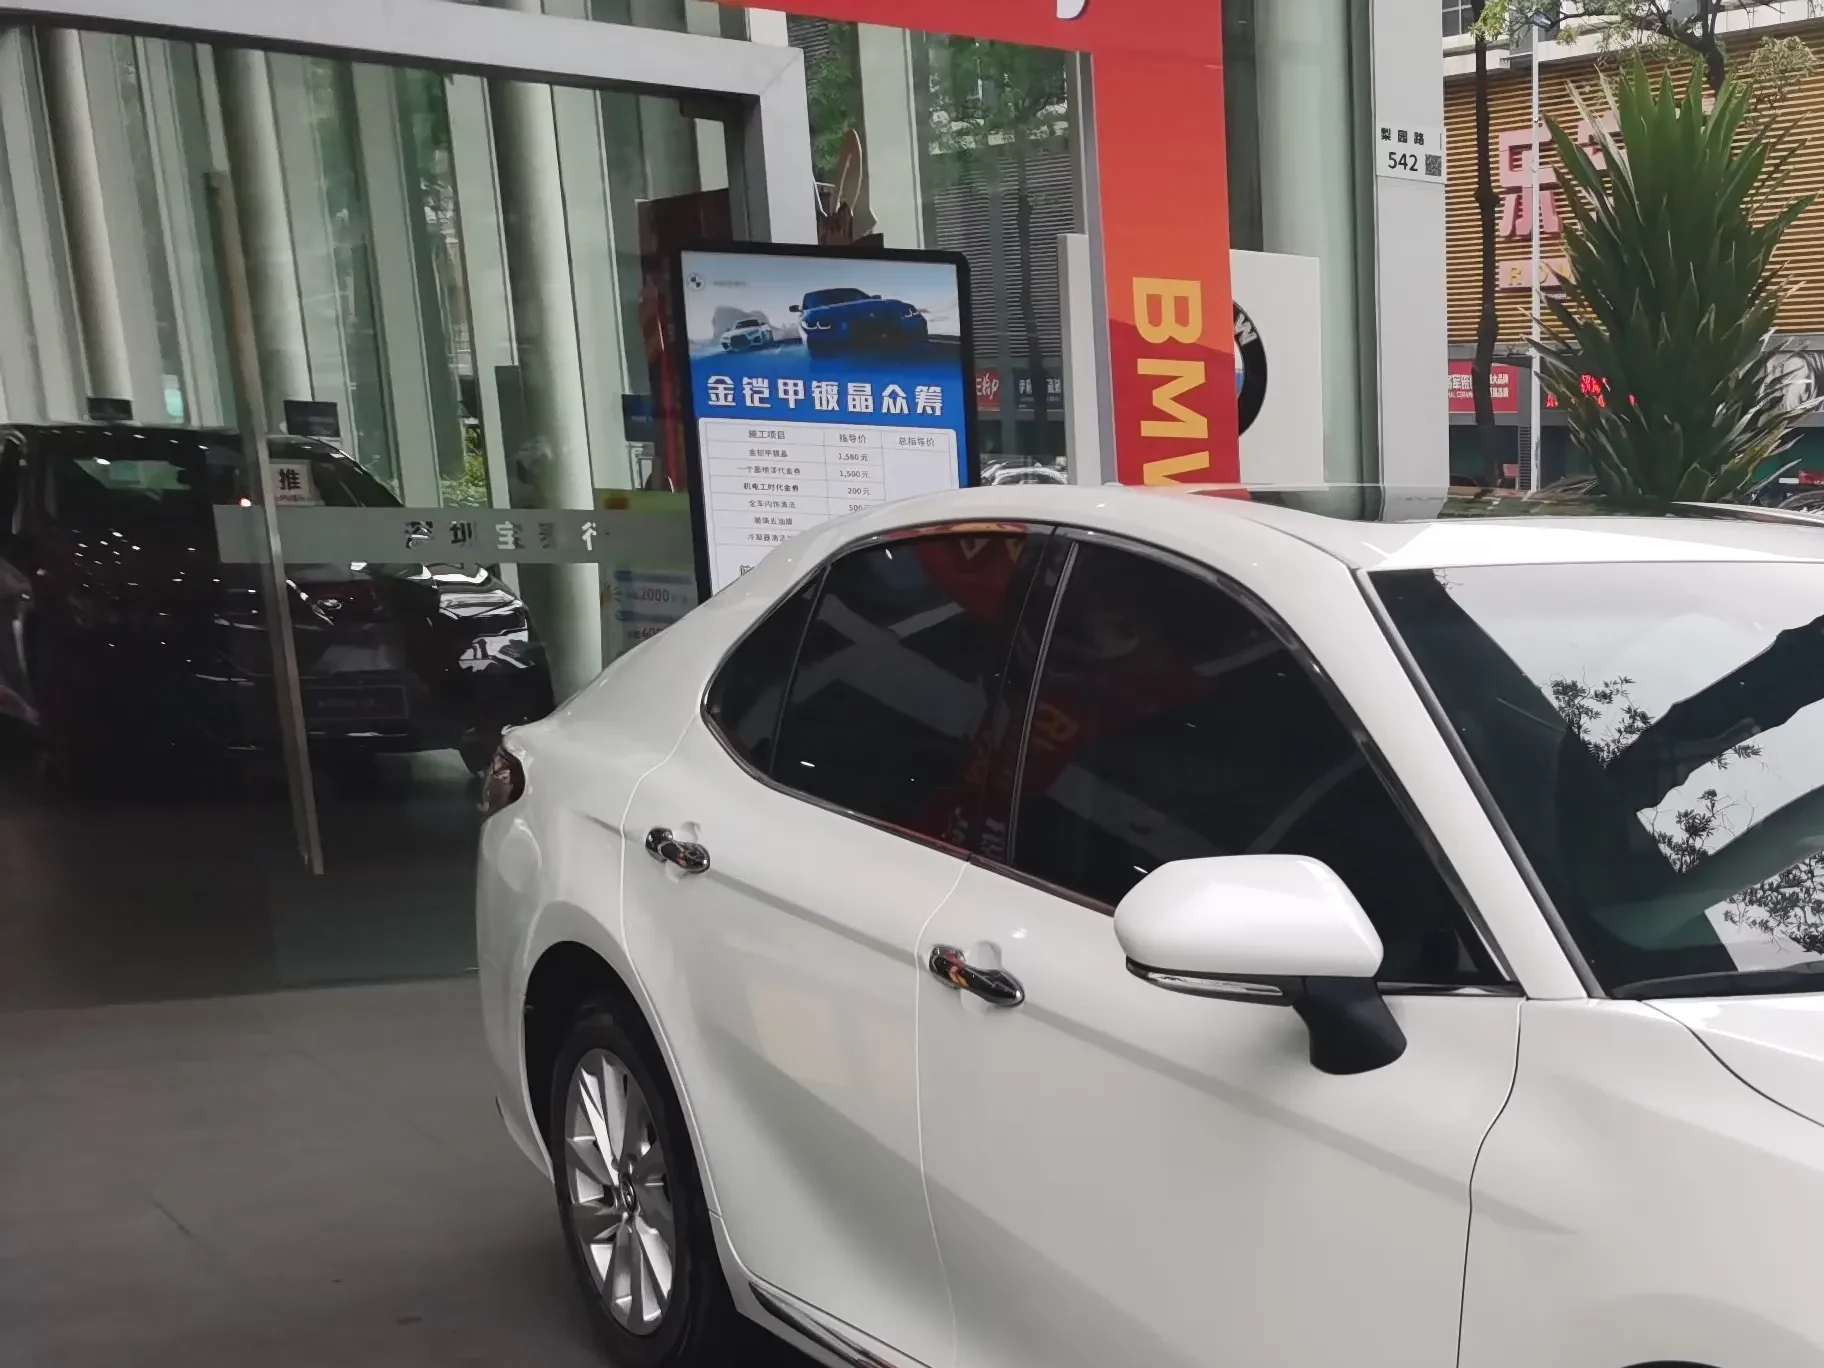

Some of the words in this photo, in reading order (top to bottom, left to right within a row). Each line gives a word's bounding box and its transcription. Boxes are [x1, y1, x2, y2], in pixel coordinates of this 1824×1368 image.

[1380, 127, 1425, 146] 梨园路
[1388, 151, 1418, 172] 542
[706, 375, 944, 417] 金铠甲镀晶众筹
